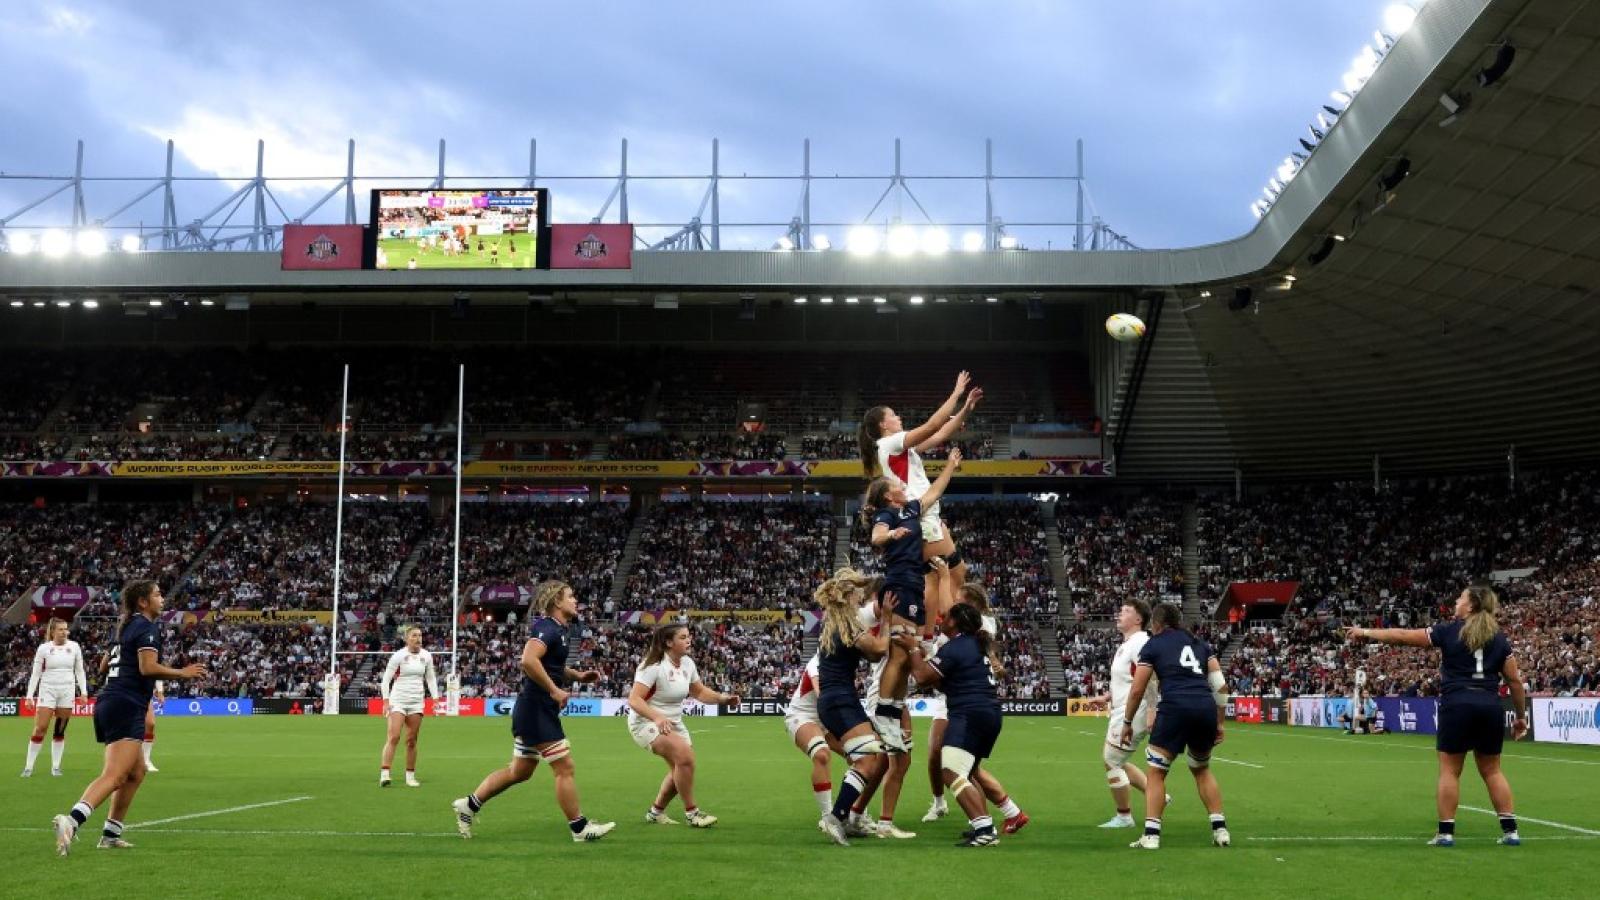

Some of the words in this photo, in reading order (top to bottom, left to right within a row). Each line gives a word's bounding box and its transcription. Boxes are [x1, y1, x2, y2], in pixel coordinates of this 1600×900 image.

[127, 465, 184, 473] WOMEN'S
[187, 465, 226, 473] RUGBY
[500, 465, 524, 473] THIS
[527, 465, 574, 473] ENERGY
[578, 465, 618, 473] NEVER
[621, 465, 659, 473] STOPS
[1179, 645, 1203, 675] 4
[1471, 649, 1485, 679] 1
[727, 702, 790, 714] DEFEN
[1001, 701, 1058, 712] stercard
[1547, 701, 1594, 741] Capgemini
